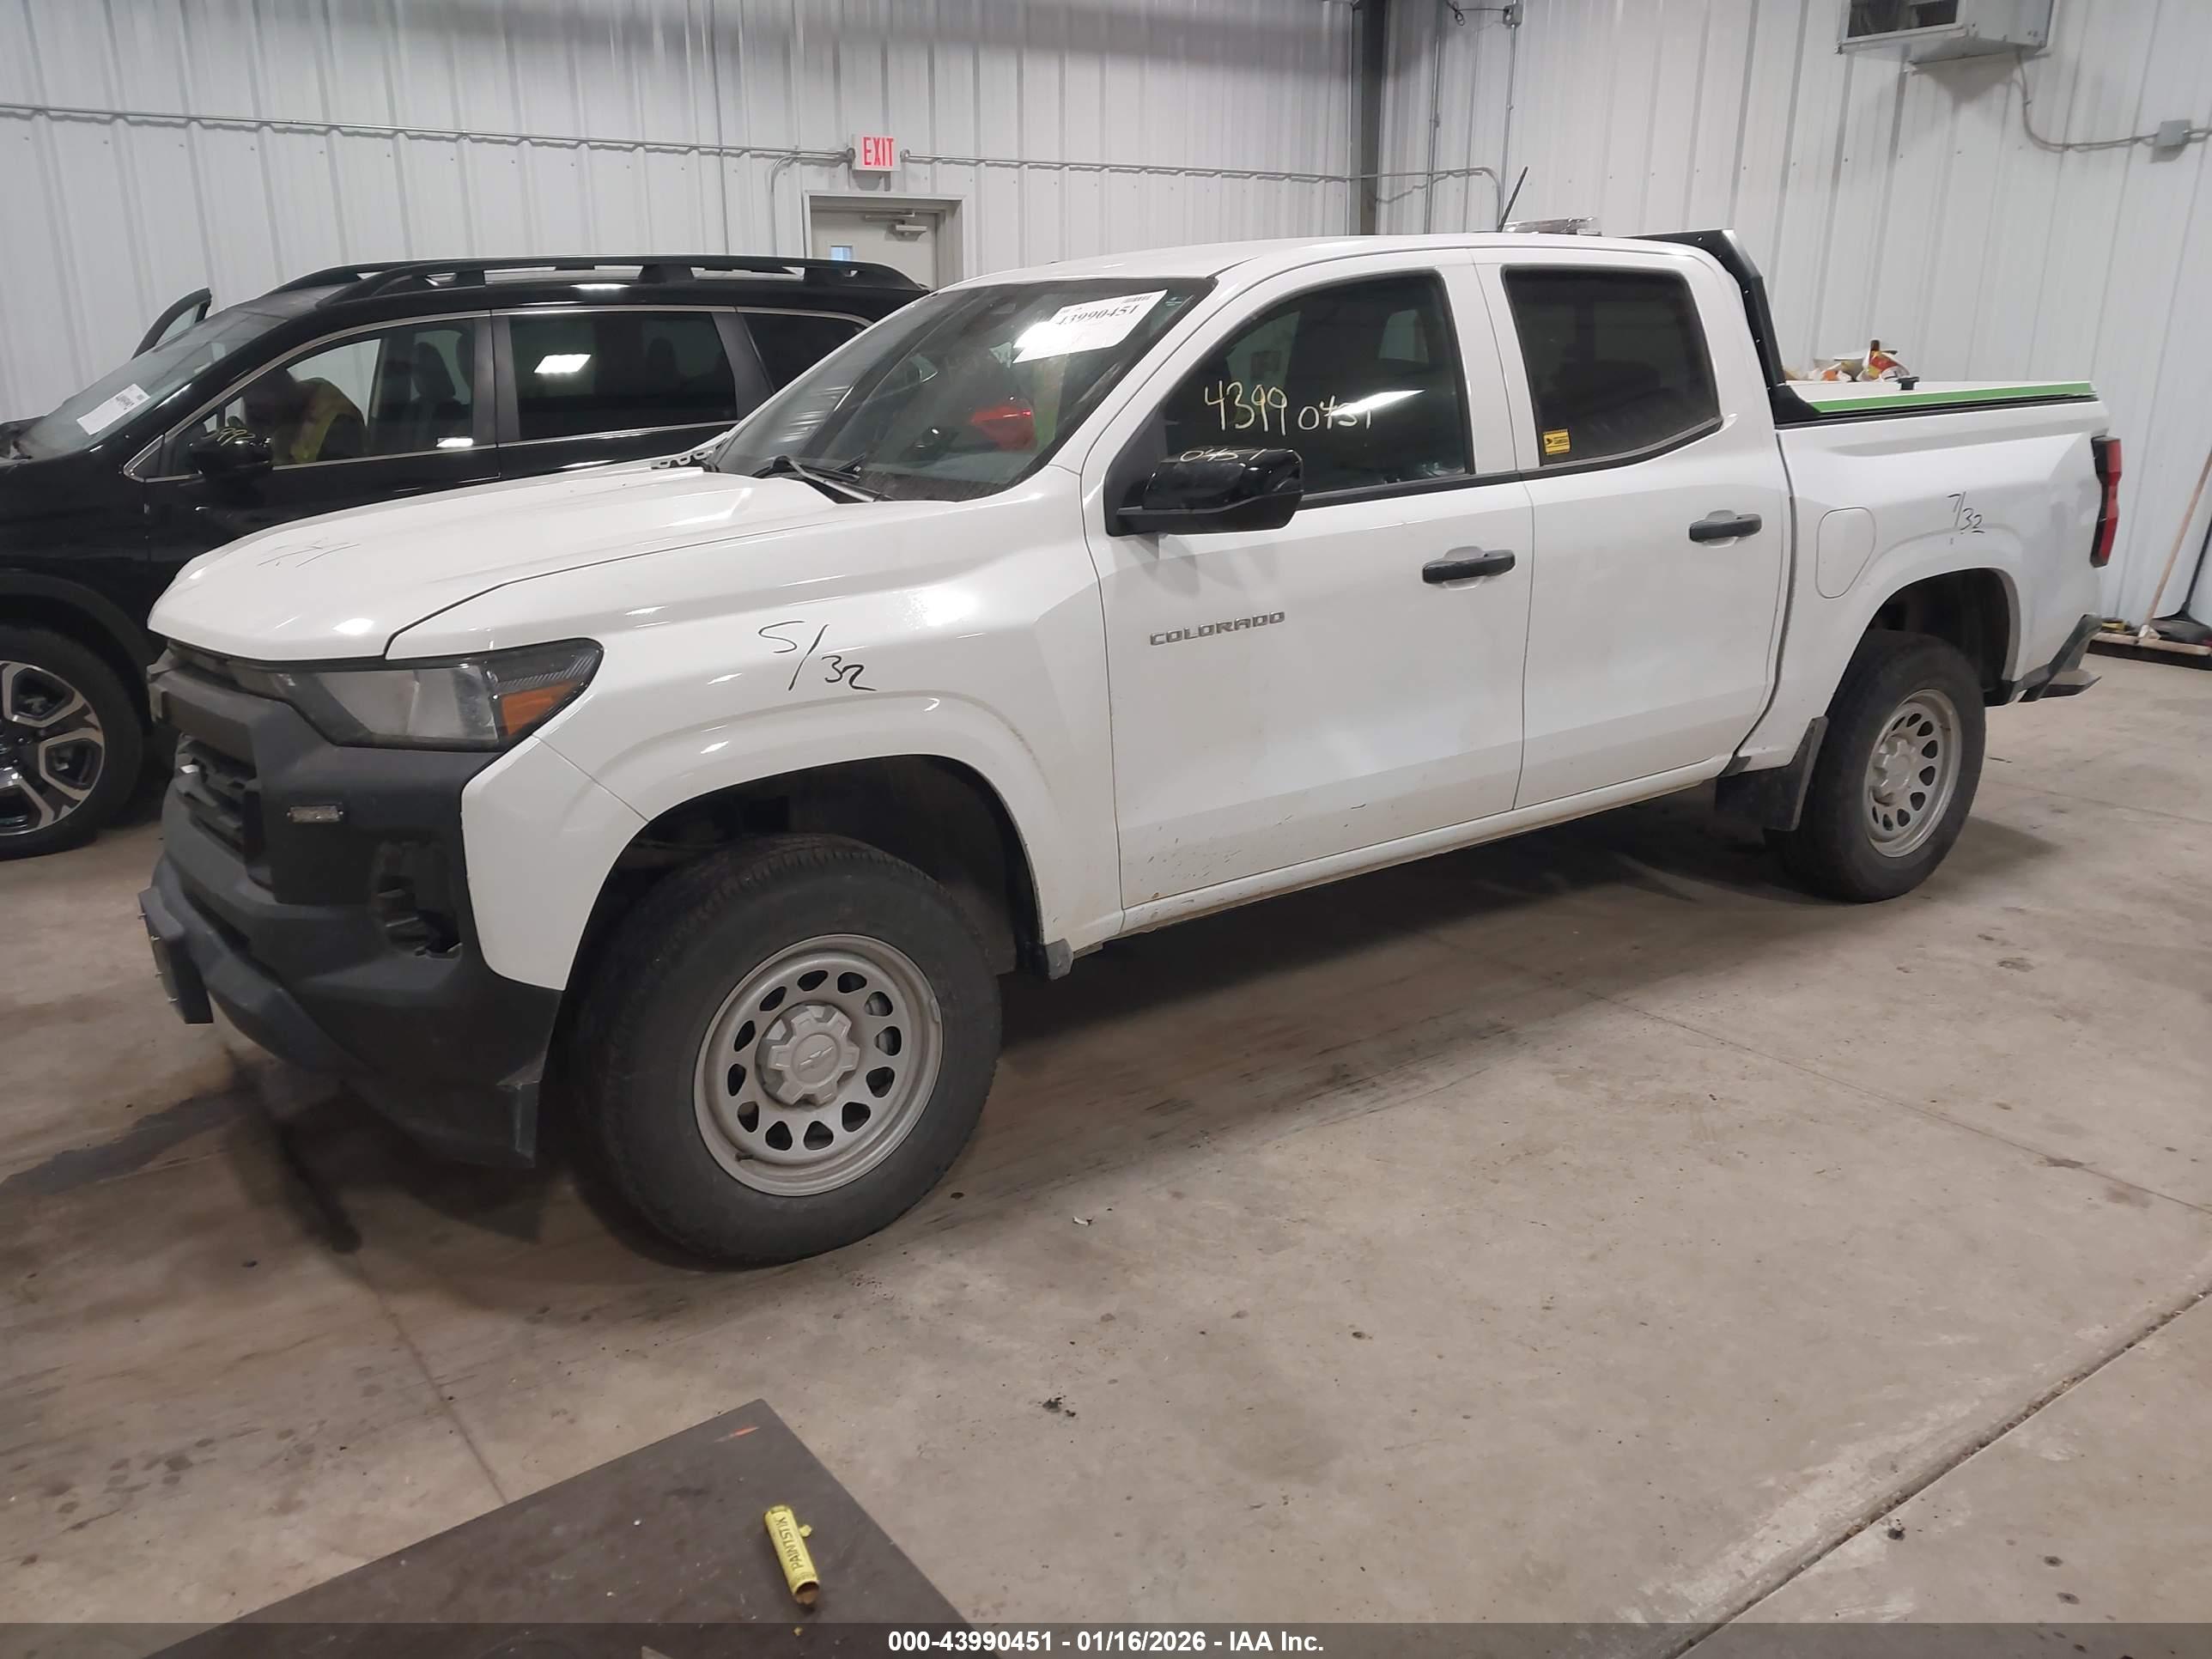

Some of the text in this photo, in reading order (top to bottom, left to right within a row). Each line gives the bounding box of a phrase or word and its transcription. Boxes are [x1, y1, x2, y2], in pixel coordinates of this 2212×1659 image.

[863, 137, 894, 167] EXIT
[1204, 380, 1372, 437] 4399 0451
[1150, 611, 1285, 646] COLORADO
